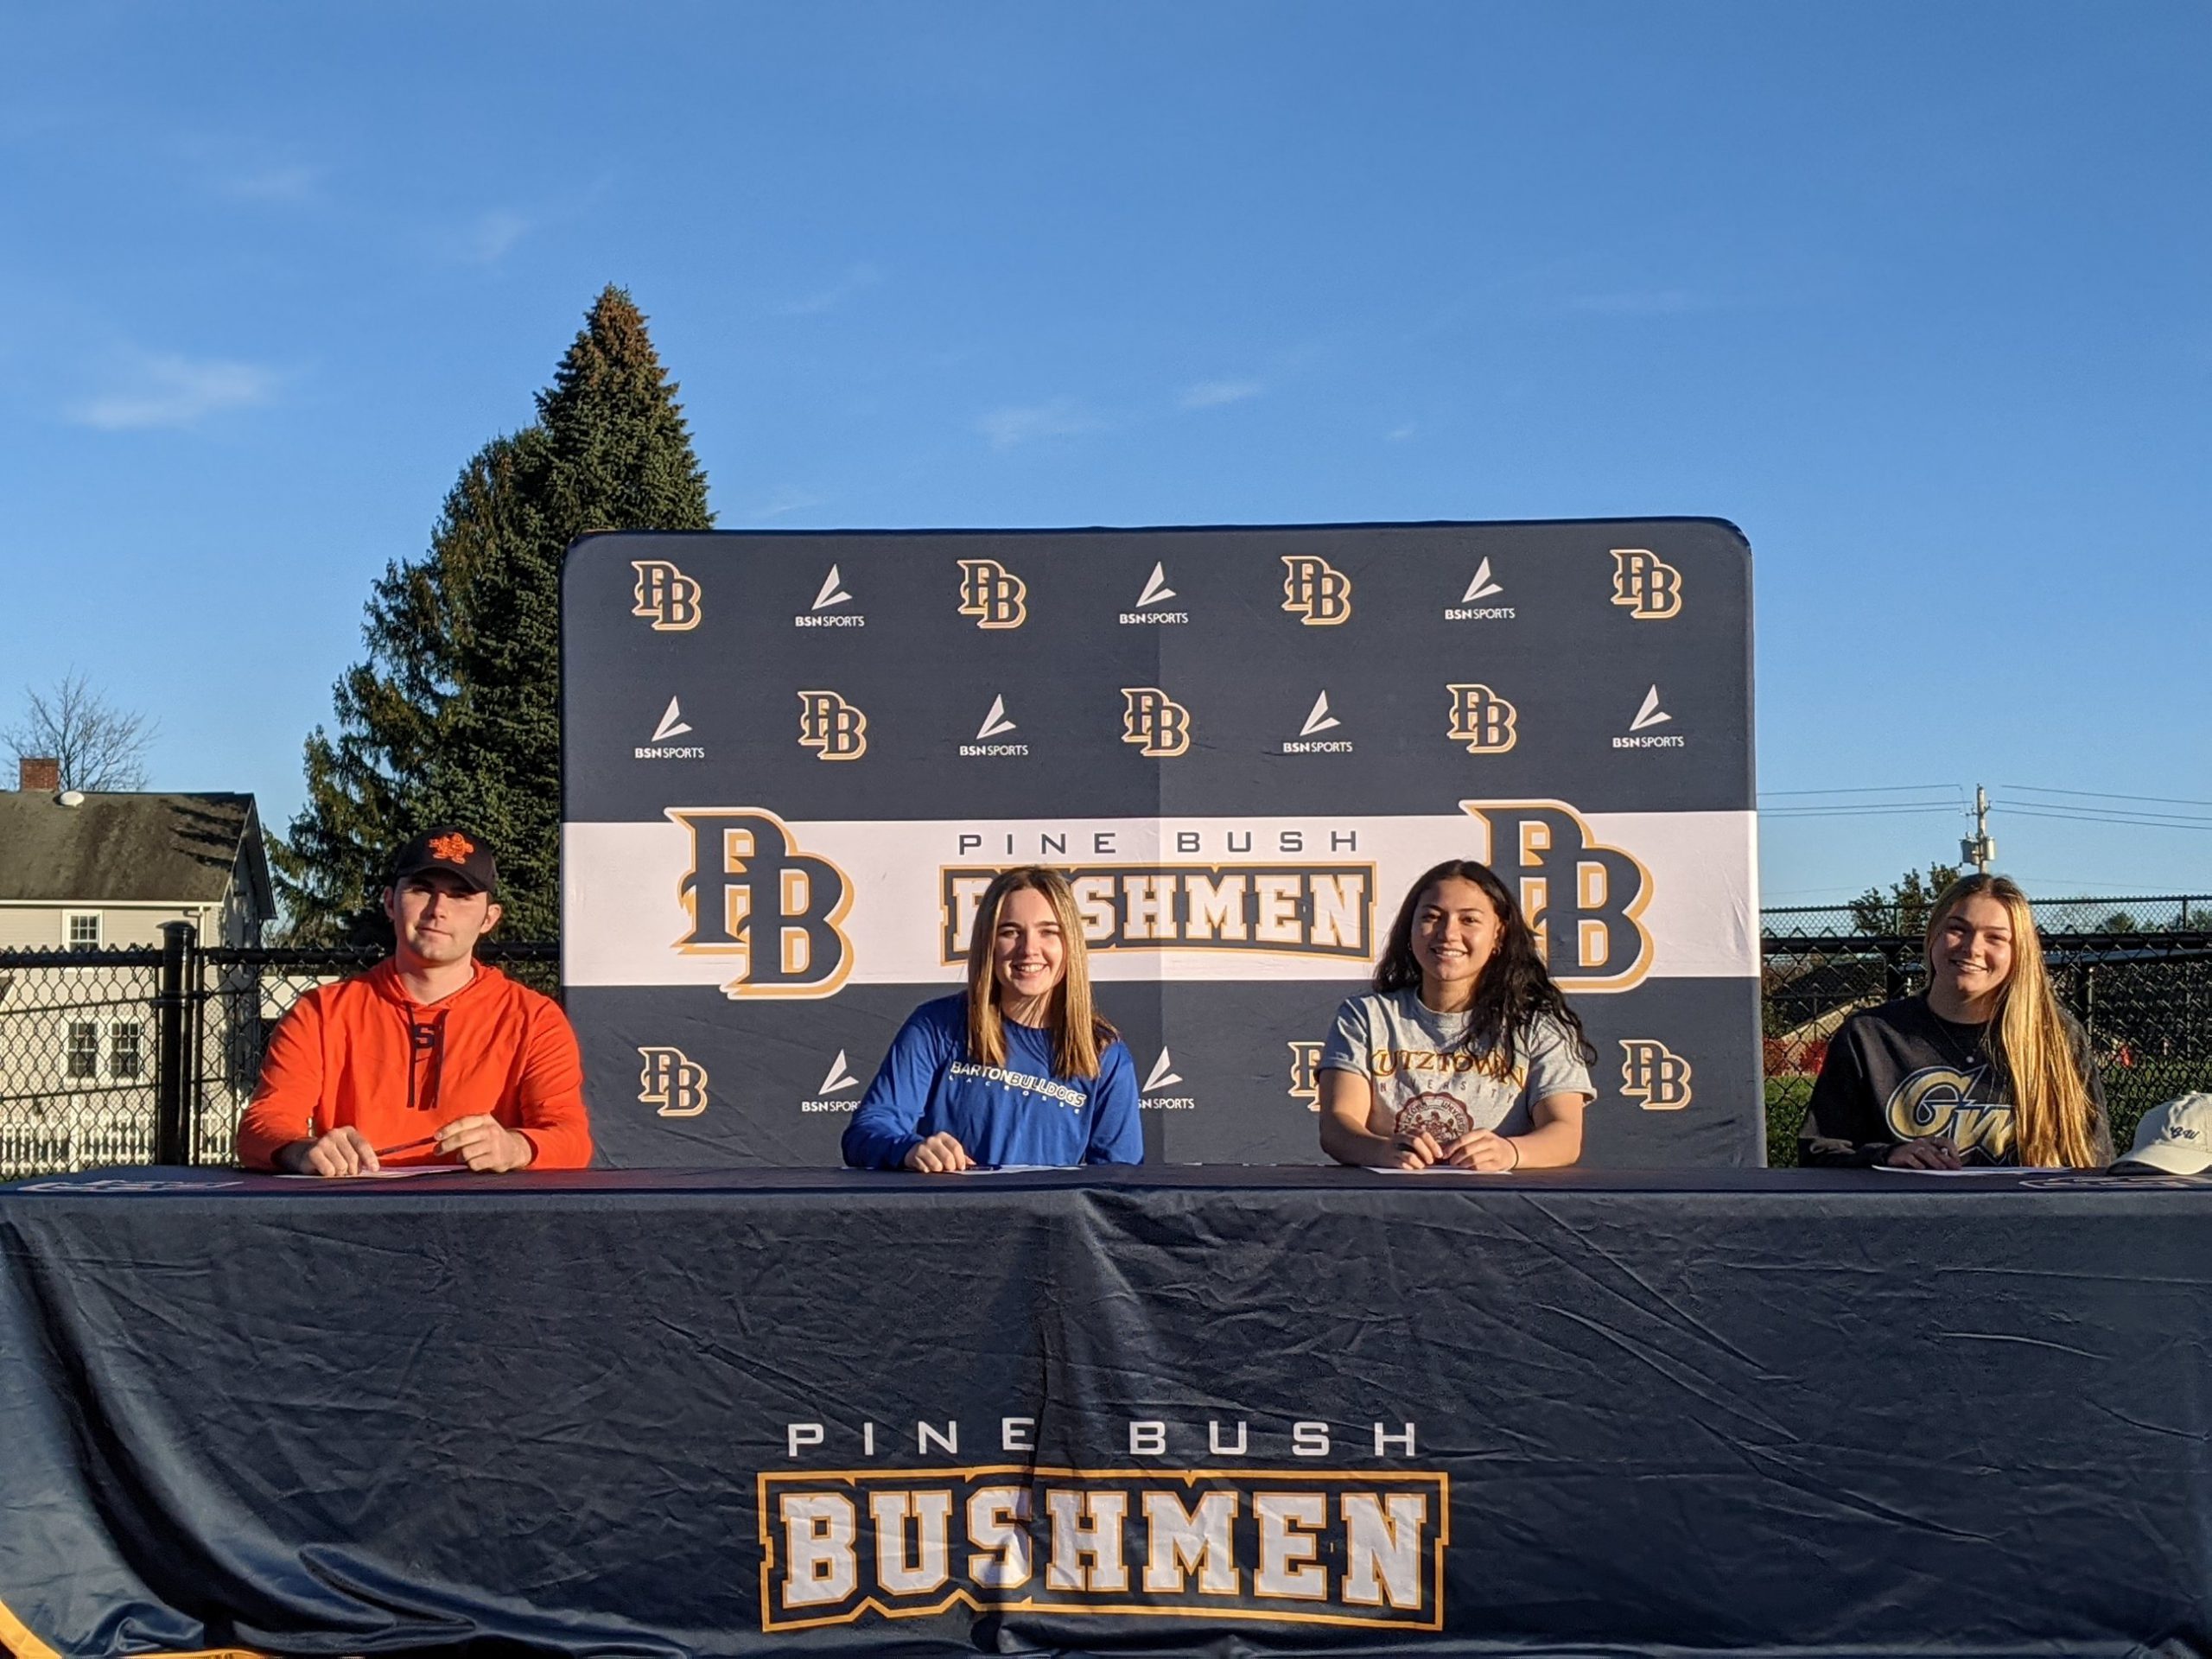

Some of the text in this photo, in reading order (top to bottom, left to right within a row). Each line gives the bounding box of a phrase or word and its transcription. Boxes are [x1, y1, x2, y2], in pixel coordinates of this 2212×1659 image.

[959, 830, 1357, 855] PINE BUSH
[413, 1022, 436, 1049] S
[788, 1417, 1416, 1457] PINE BUSH
[779, 1485, 1427, 1610] BUSHMEN
